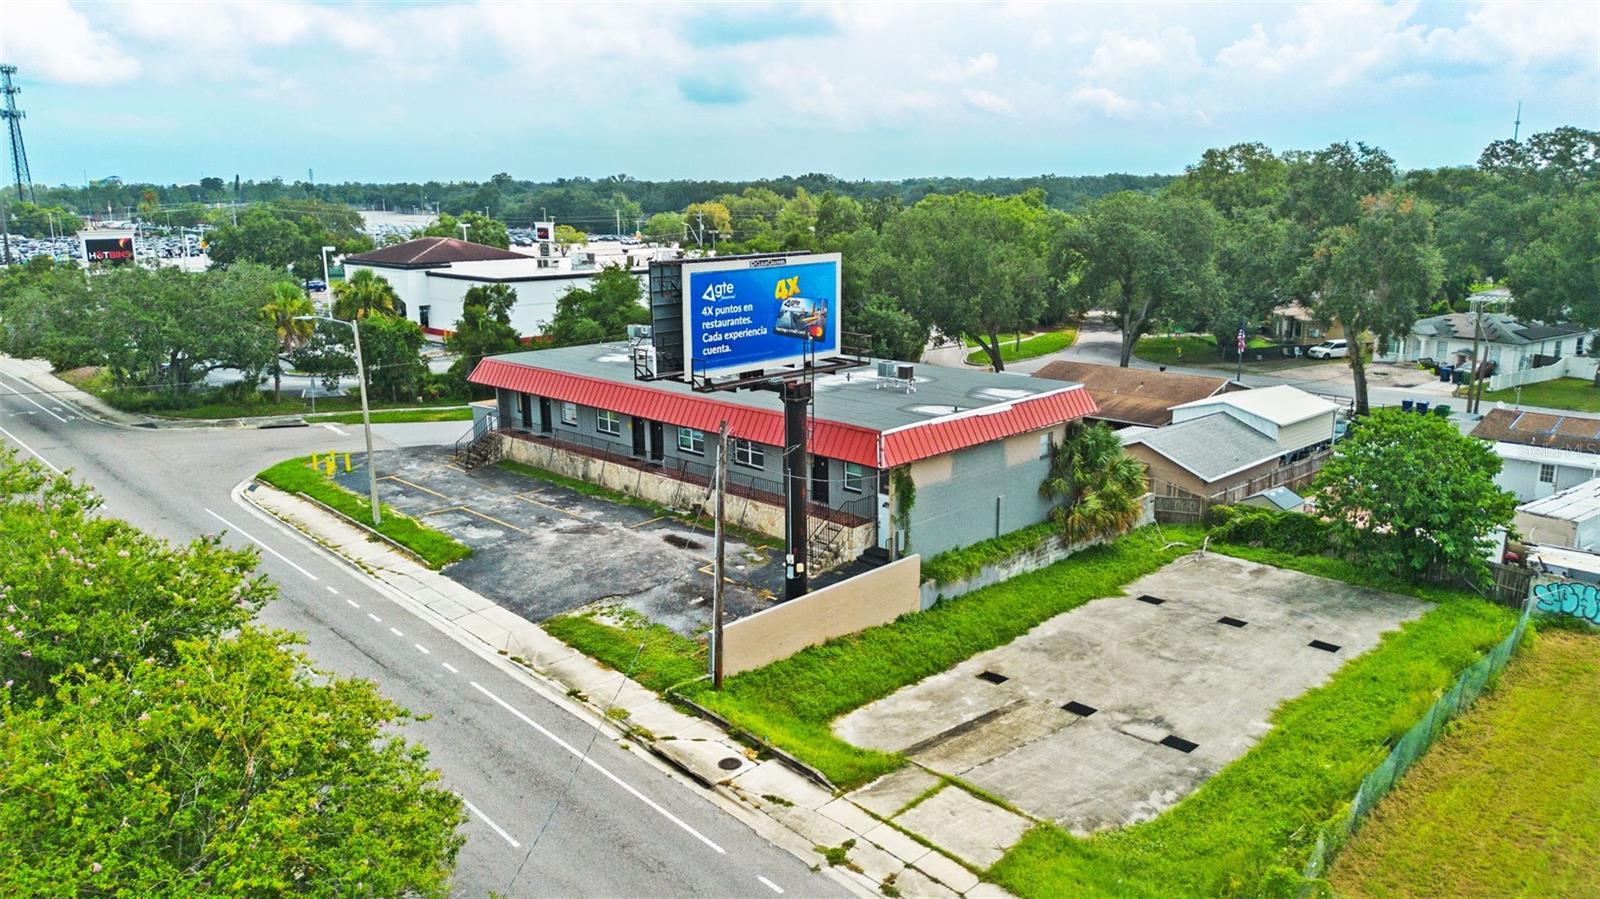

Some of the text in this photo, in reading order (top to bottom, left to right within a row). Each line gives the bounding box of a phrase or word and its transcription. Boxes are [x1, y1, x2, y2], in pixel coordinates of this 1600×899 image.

[714, 281, 735, 298] gte
[775, 275, 800, 300] 4X
[701, 303, 753, 317] 4X puntos en
[702, 331, 723, 343] Cada
[724, 325, 768, 341] experiencia
[702, 343, 732, 356] cuenta.
